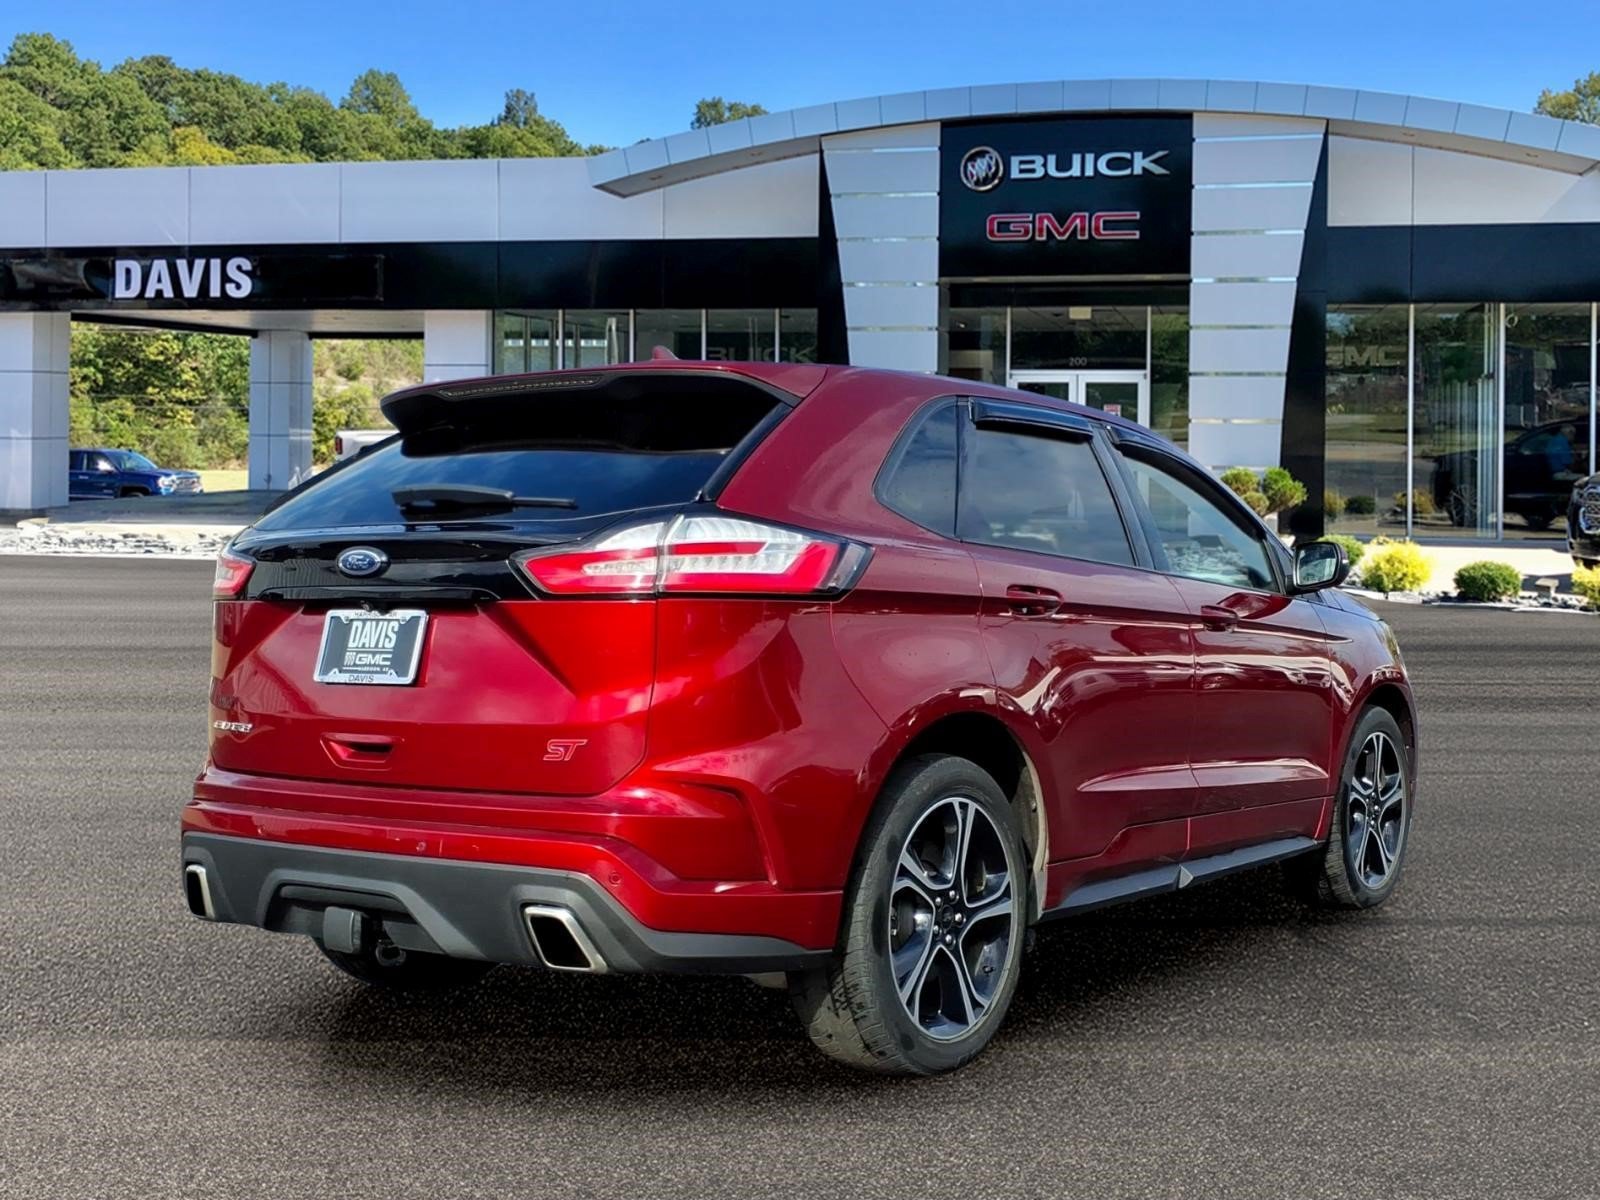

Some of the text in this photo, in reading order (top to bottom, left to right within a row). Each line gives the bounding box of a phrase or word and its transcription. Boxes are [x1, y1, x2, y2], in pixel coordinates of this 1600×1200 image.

[1010, 150, 1170, 179] BUICK
[986, 211, 1141, 242] GMC
[114, 257, 253, 299] DAVIS
[1068, 356, 1088, 367] 200
[347, 620, 400, 649] DAVIS
[355, 653, 393, 666] GMC
[347, 674, 375, 683] DAVIS
[543, 738, 588, 761] ST
